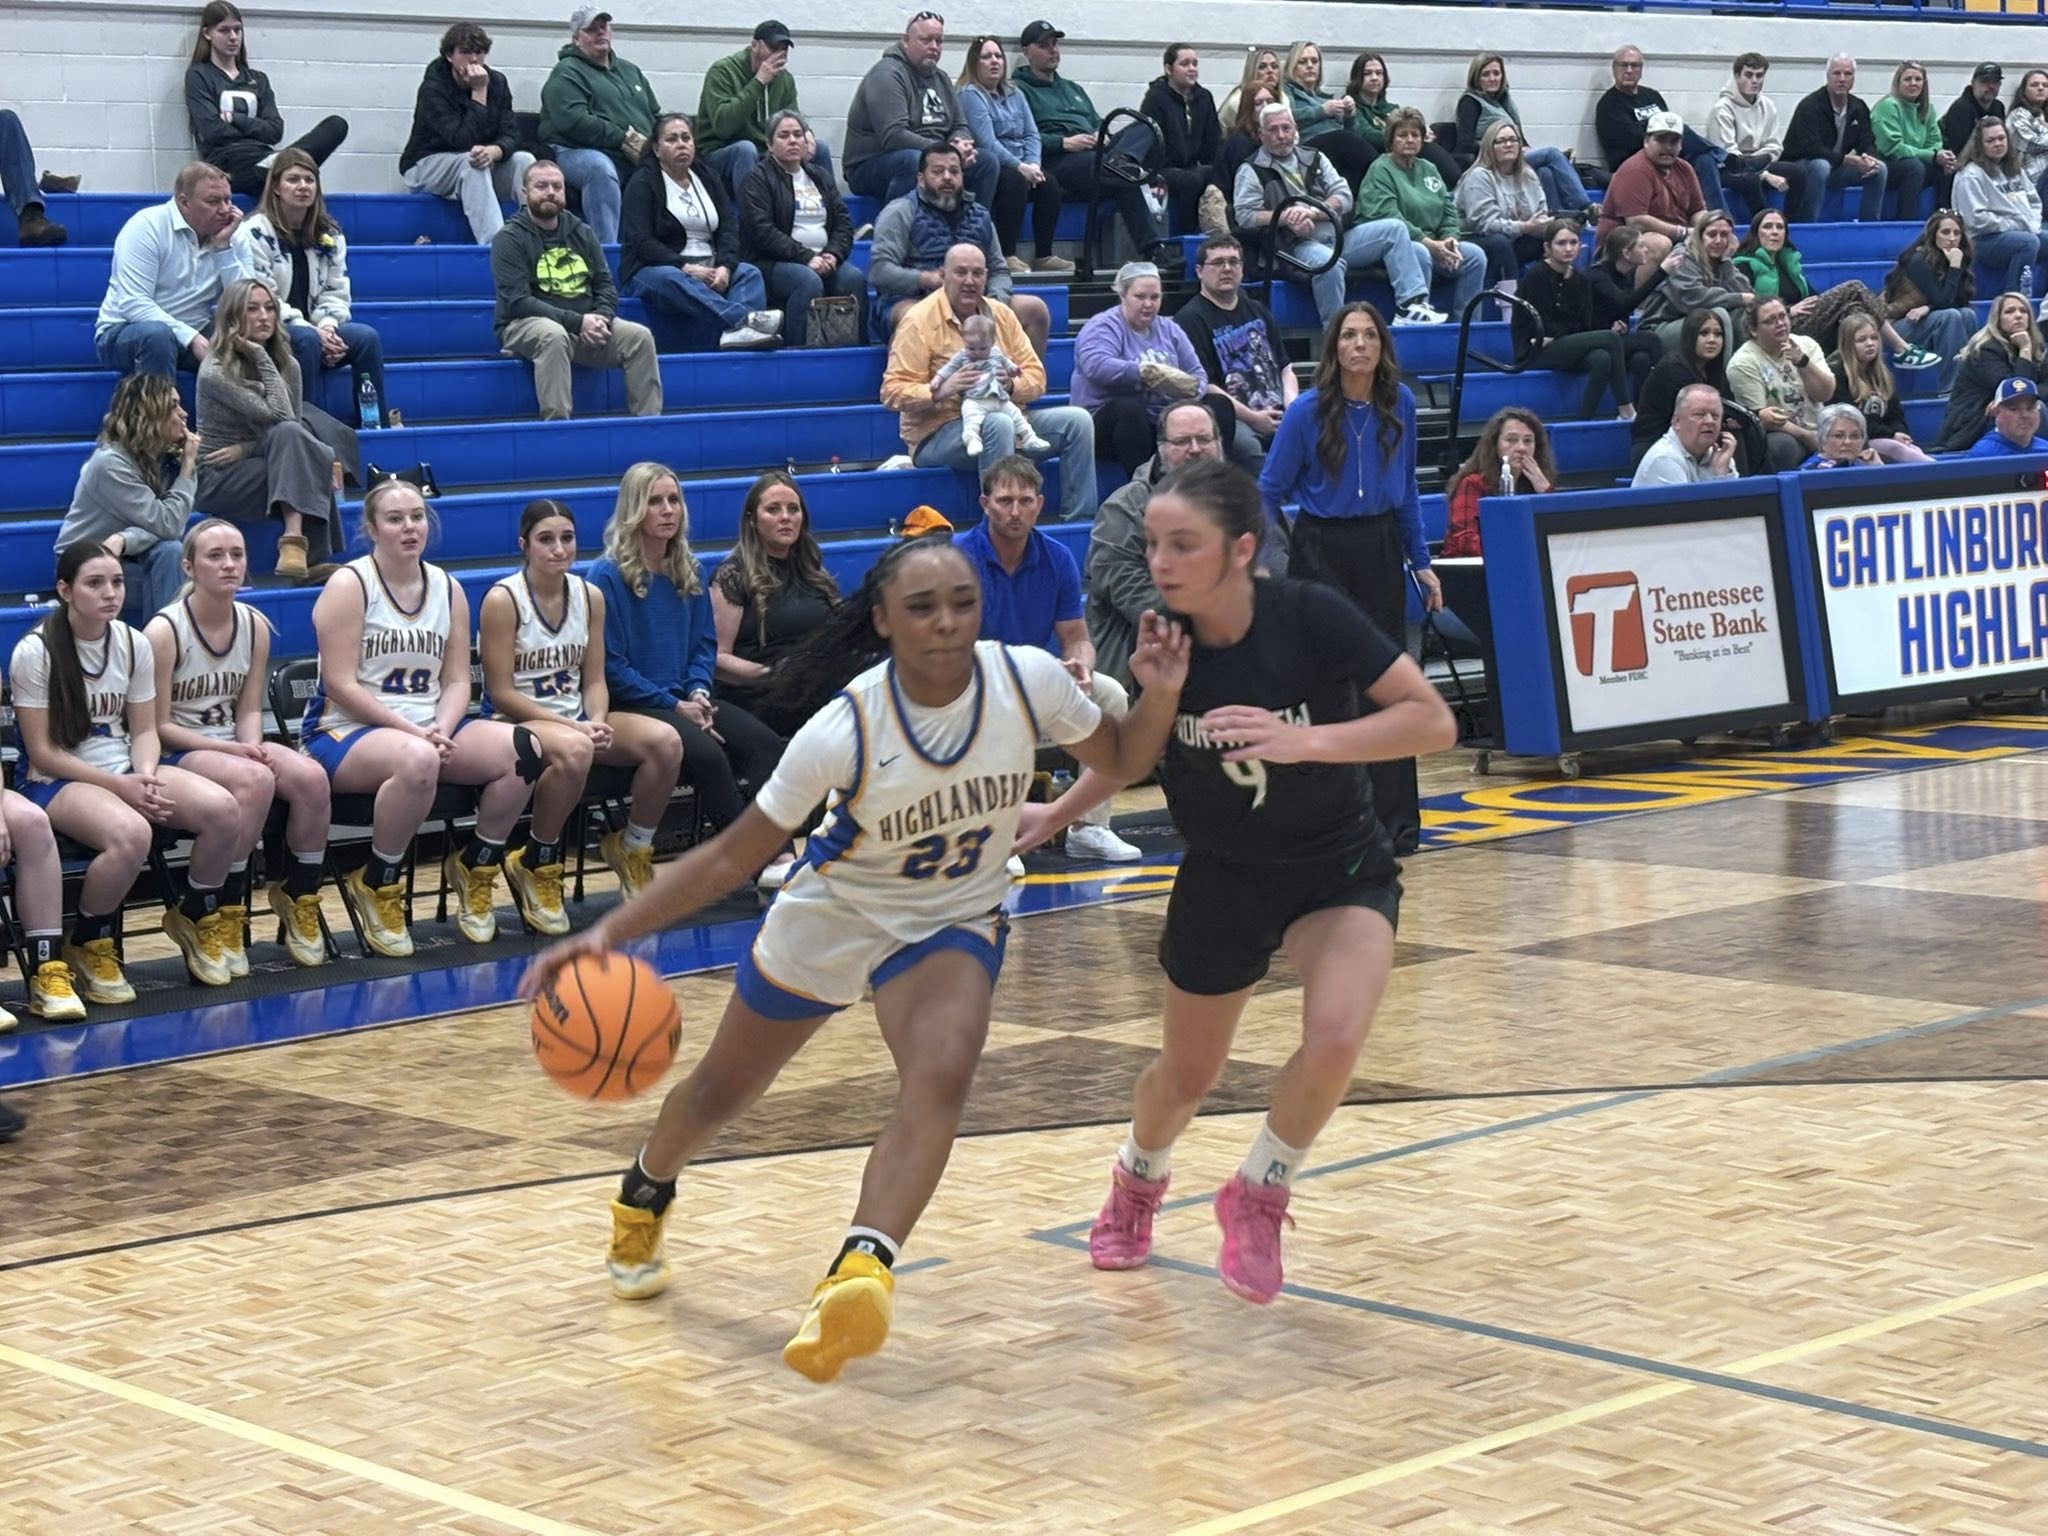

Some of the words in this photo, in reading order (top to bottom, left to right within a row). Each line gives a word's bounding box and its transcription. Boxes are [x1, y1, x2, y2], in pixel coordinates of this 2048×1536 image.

[1648, 585, 1764, 613] Tennessee
[1653, 618, 1706, 644] State
[1710, 608, 1768, 638] Bank
[1712, 649, 1720, 657] at
[1599, 674, 1627, 685] Member
[1628, 671, 1648, 683] FDIC
[1221, 759, 1267, 810] 9
[901, 825, 994, 880] 23
